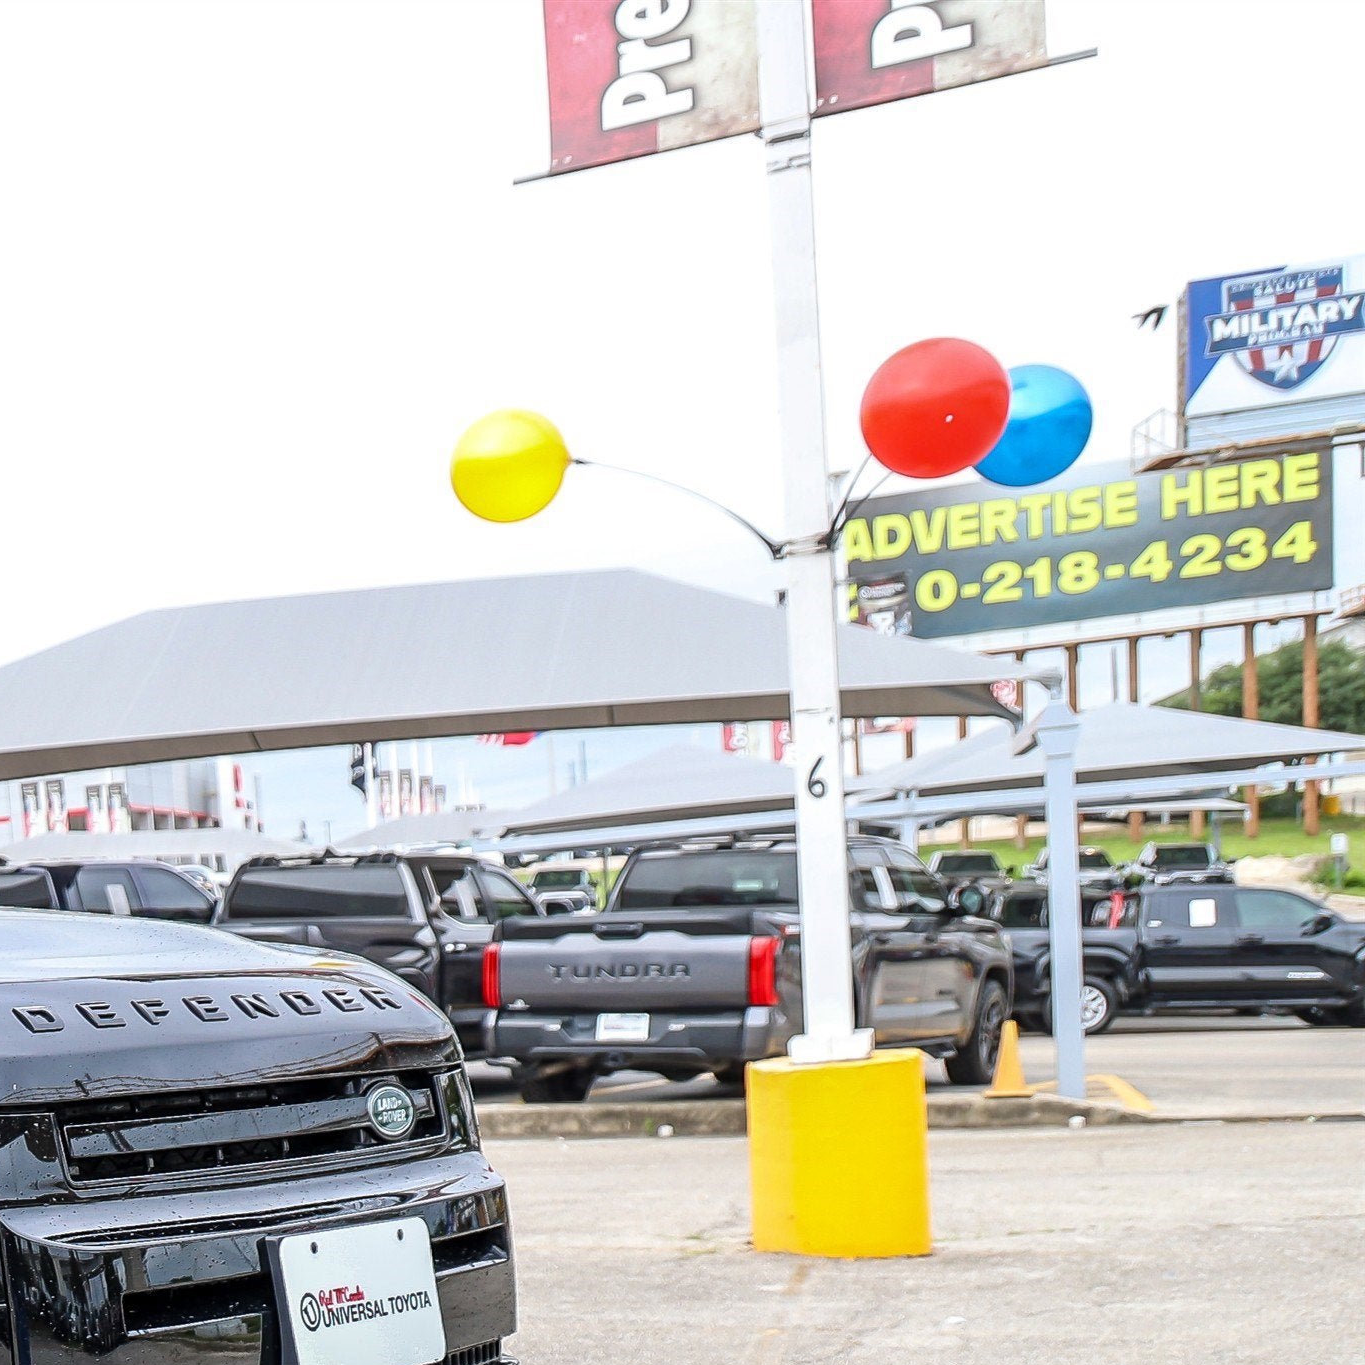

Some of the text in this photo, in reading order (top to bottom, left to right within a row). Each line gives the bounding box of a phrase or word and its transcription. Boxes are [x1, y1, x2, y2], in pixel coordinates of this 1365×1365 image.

[1253, 278, 1317, 297] SALUTE
[1211, 294, 1363, 343] MILITARY
[846, 451, 1321, 564] ADVERTISE HERE
[807, 755, 825, 798] 6
[548, 963, 691, 983] TUNDRA
[11, 987, 403, 1034] DEFENDER
[322, 1291, 432, 1327] UNIVERSAL TOYOTA
